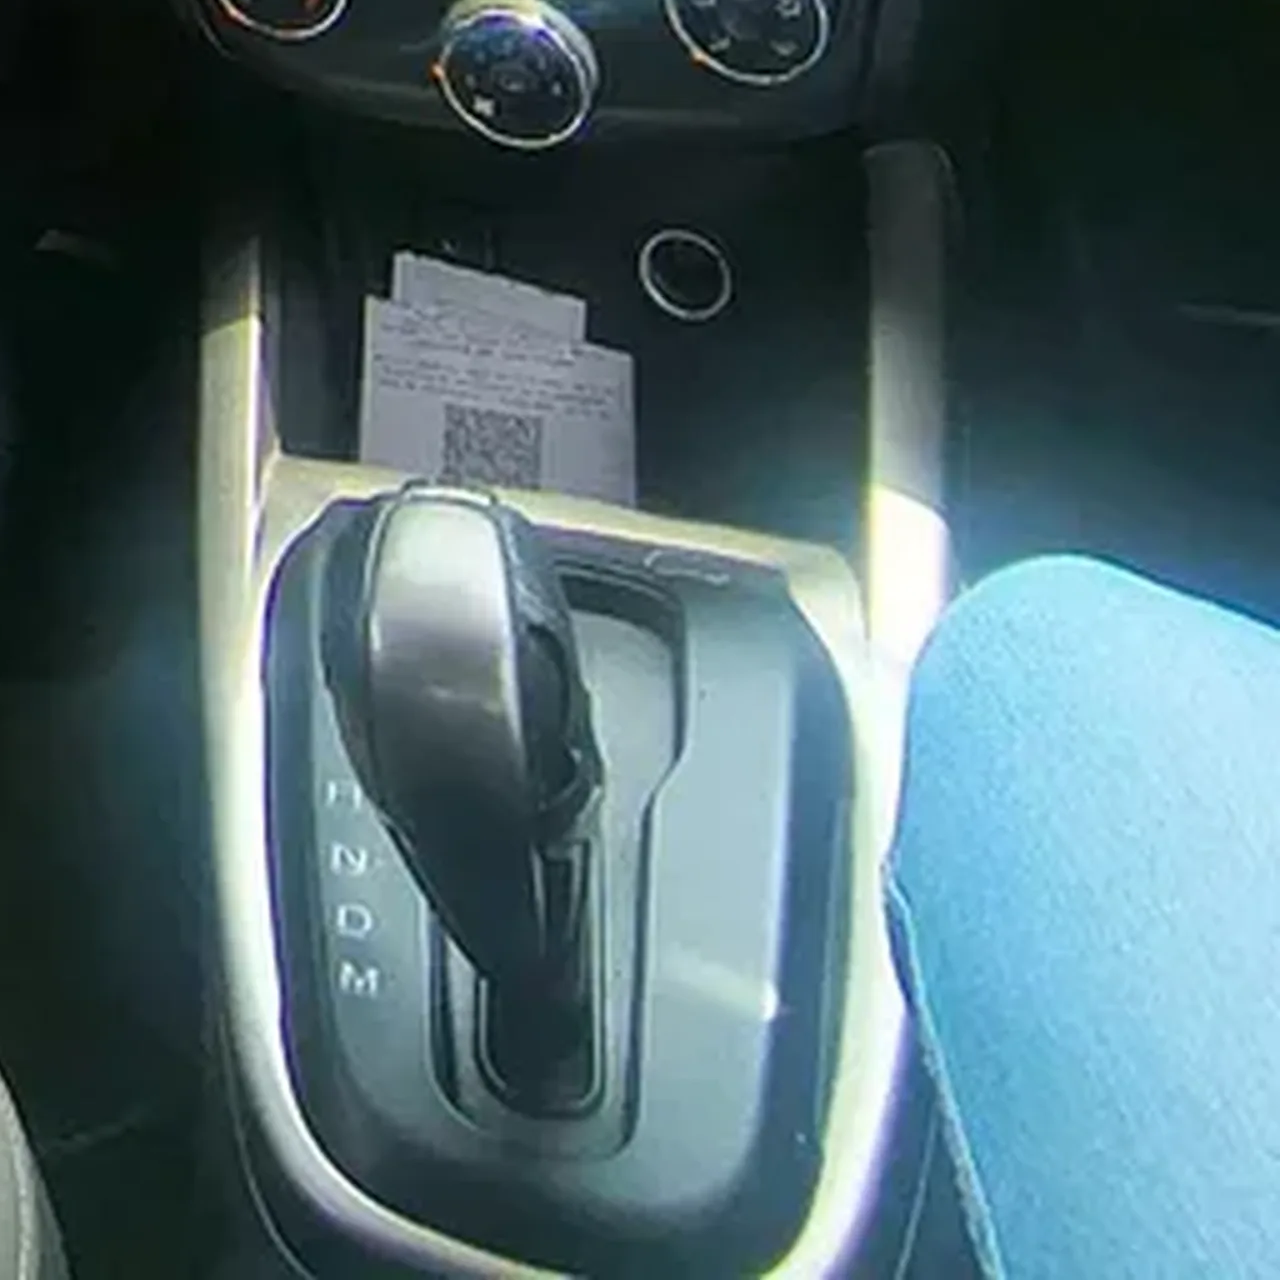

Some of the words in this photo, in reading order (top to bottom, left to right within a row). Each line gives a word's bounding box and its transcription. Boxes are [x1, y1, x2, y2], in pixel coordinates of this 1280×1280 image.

[331, 842, 368, 875] N
[339, 904, 373, 939] D
[341, 961, 380, 998] M
